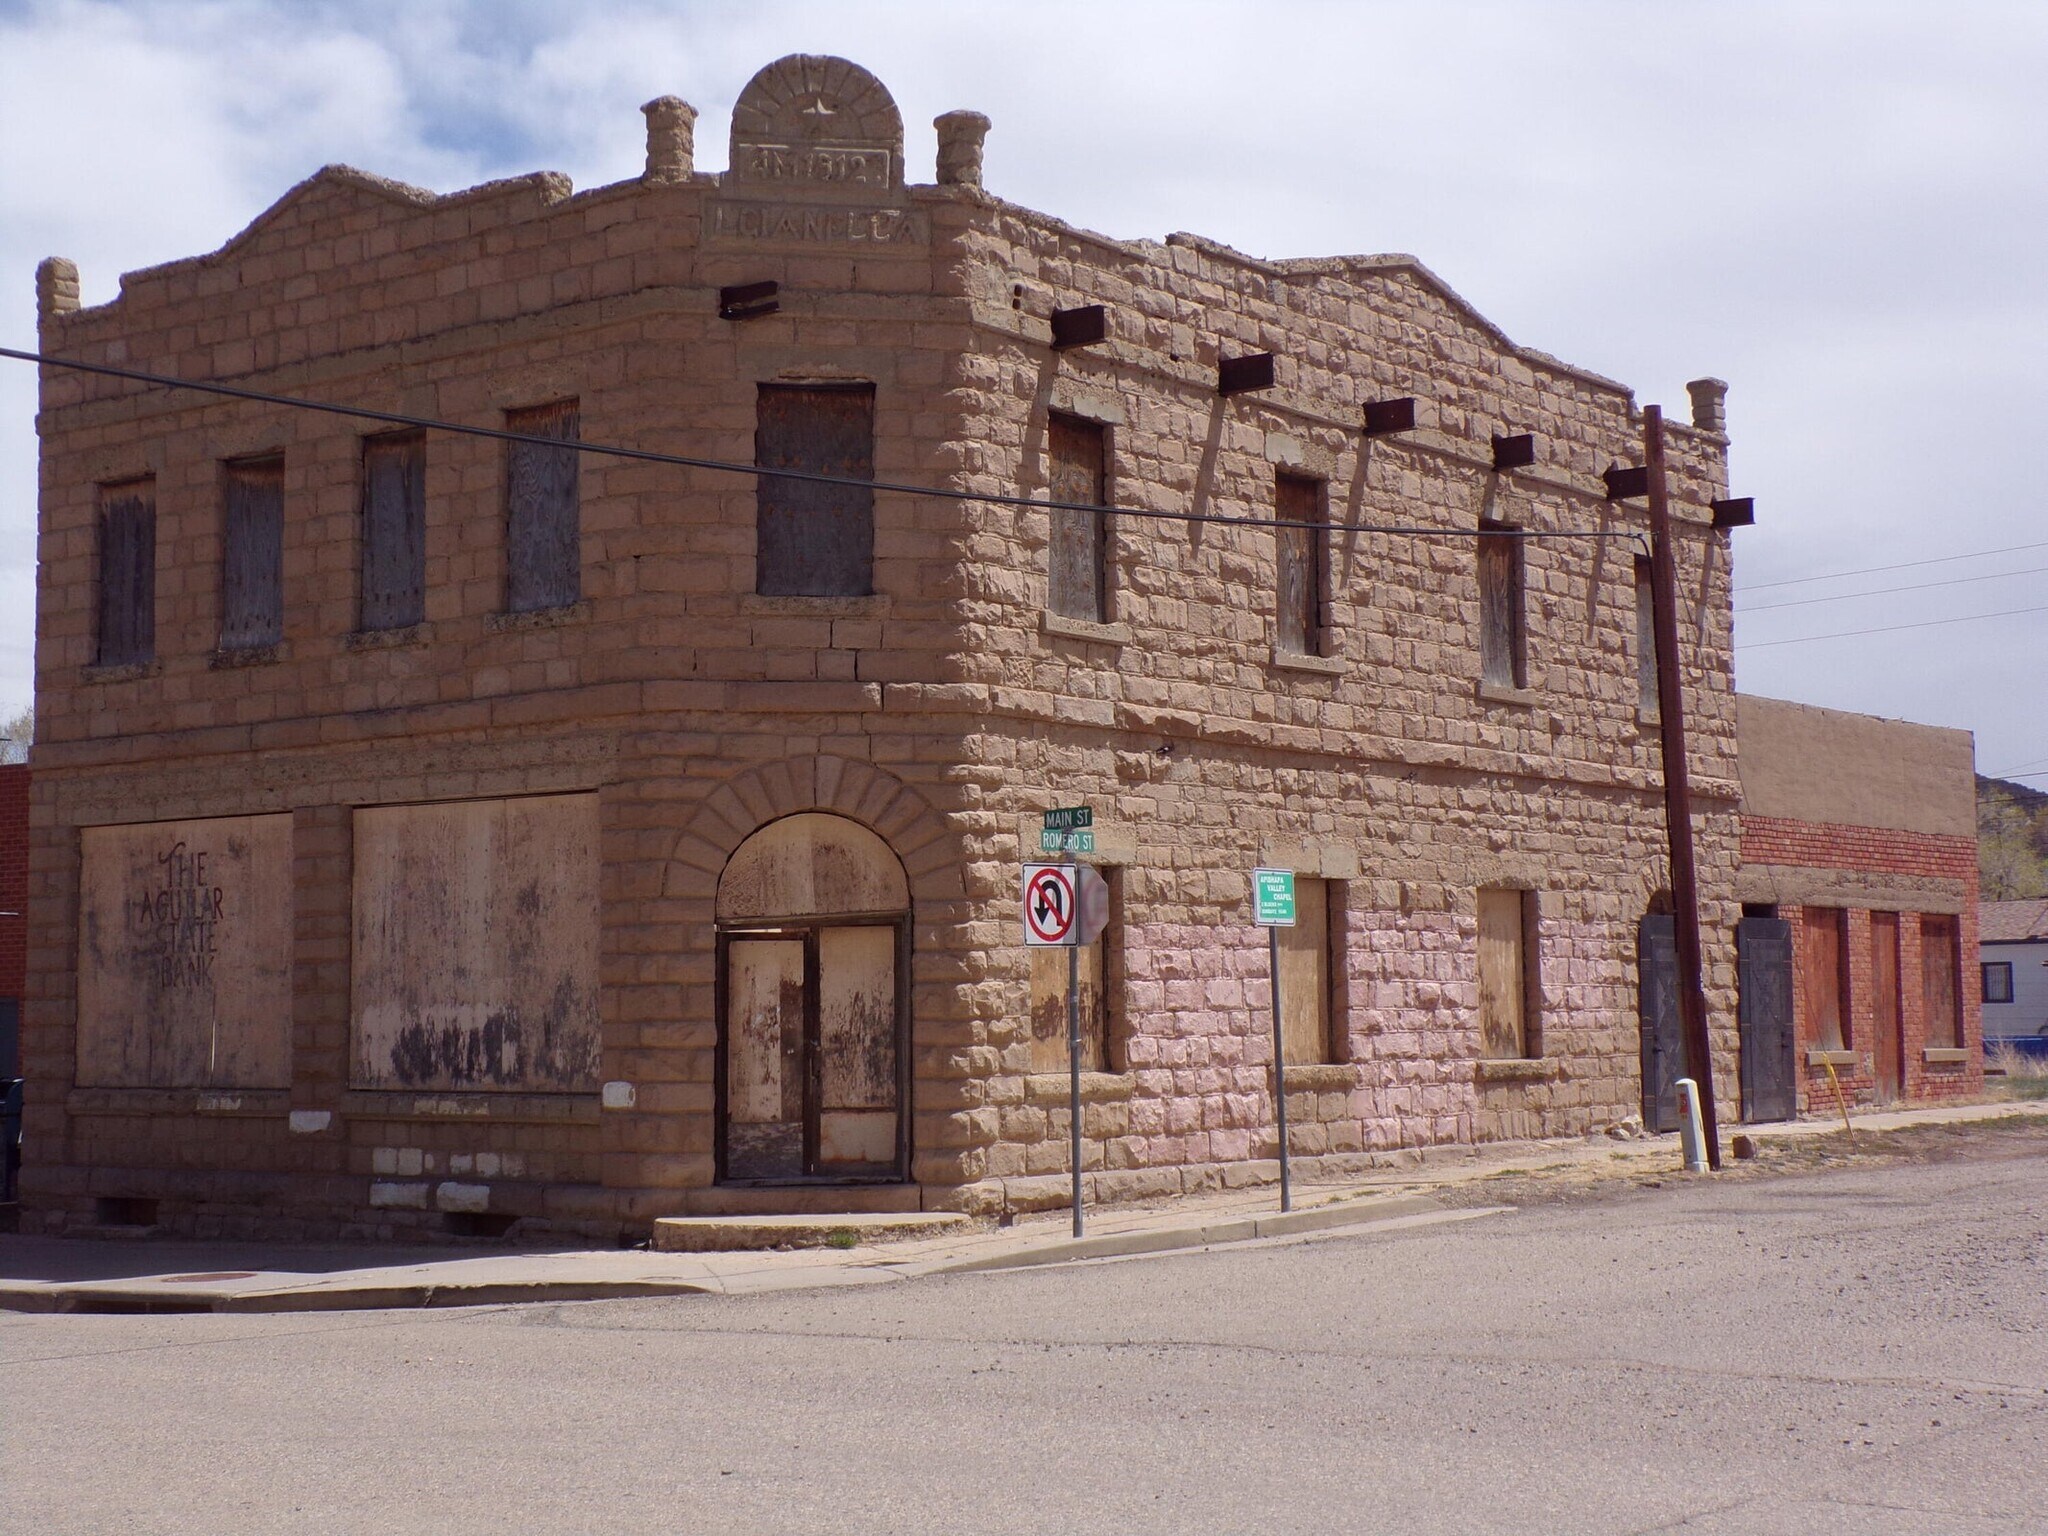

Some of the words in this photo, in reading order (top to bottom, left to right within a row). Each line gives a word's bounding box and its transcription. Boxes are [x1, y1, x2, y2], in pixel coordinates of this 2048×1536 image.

[1046, 811, 1072, 828] MAIN
[1076, 809, 1090, 825] ST
[1043, 832, 1080, 850] ROMERO
[1083, 834, 1092, 850] ST
[158, 842, 207, 887] THE
[140, 887, 224, 924] AGUILAR
[156, 919, 218, 955] STATE
[161, 955, 215, 989] BANK
